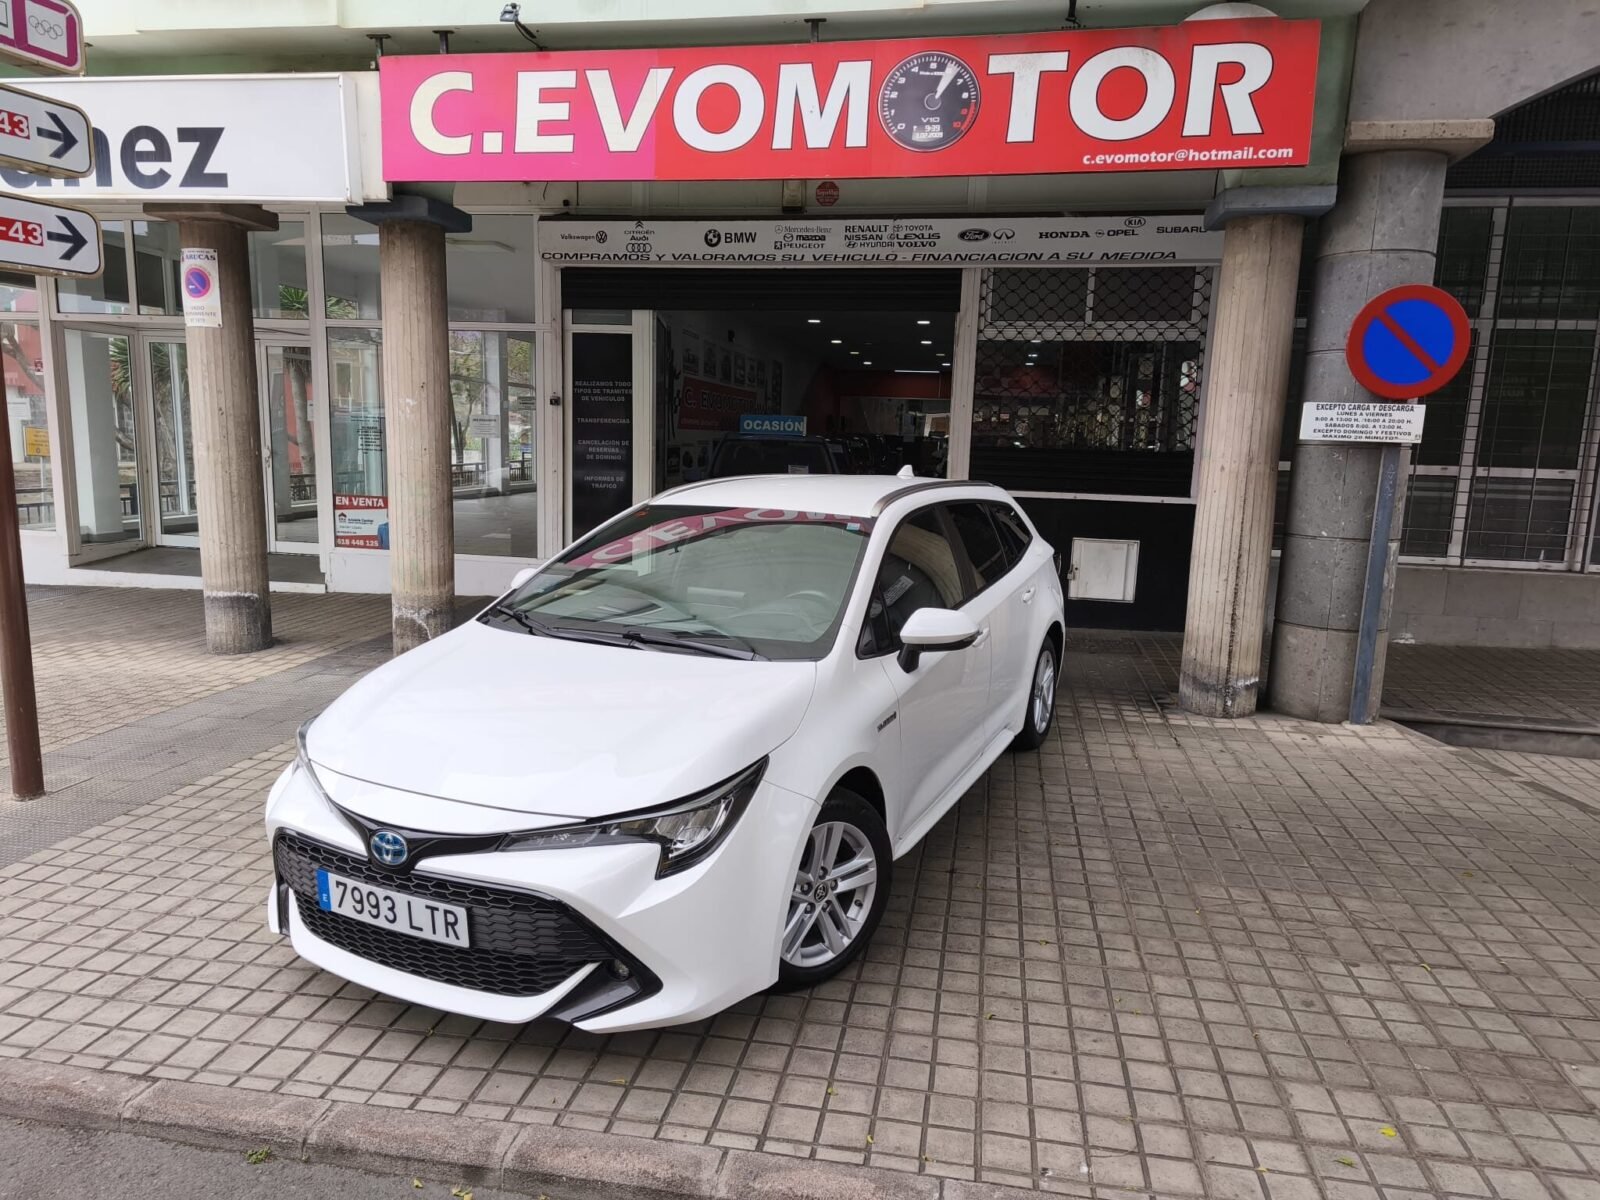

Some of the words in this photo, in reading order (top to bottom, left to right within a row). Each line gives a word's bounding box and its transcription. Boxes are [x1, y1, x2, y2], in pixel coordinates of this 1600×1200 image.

[1082, 145, 1294, 165] c.evomotor@hotmail.com
[784, 225, 832, 234] Mercedes-Benz
[844, 225, 889, 233] RENAULT
[1107, 229, 1138, 237] OPEL
[724, 232, 757, 243] BMW
[964, 231, 984, 240] Ford
[1039, 231, 1090, 239] HONDA
[541, 252, 650, 261] COMPRAMOS
[656, 253, 666, 261] Y
[671, 253, 777, 261] VALORAMOS
[781, 253, 806, 261] SU
[812, 253, 898, 262] VEHICULO
[911, 252, 1045, 262] FINANCIACION
[1047, 252, 1061, 260] A
[1066, 252, 1094, 260] SU
[1099, 251, 1177, 260] MEDIDA
[1316, 403, 1346, 411] EXCEPTO
[1379, 404, 1415, 412] DESCARGA
[743, 418, 805, 432] OCASIÓN
[335, 496, 350, 506] EN
[351, 497, 385, 507] VENTA
[335, 880, 398, 925] 7993
[407, 900, 460, 941] LTR
